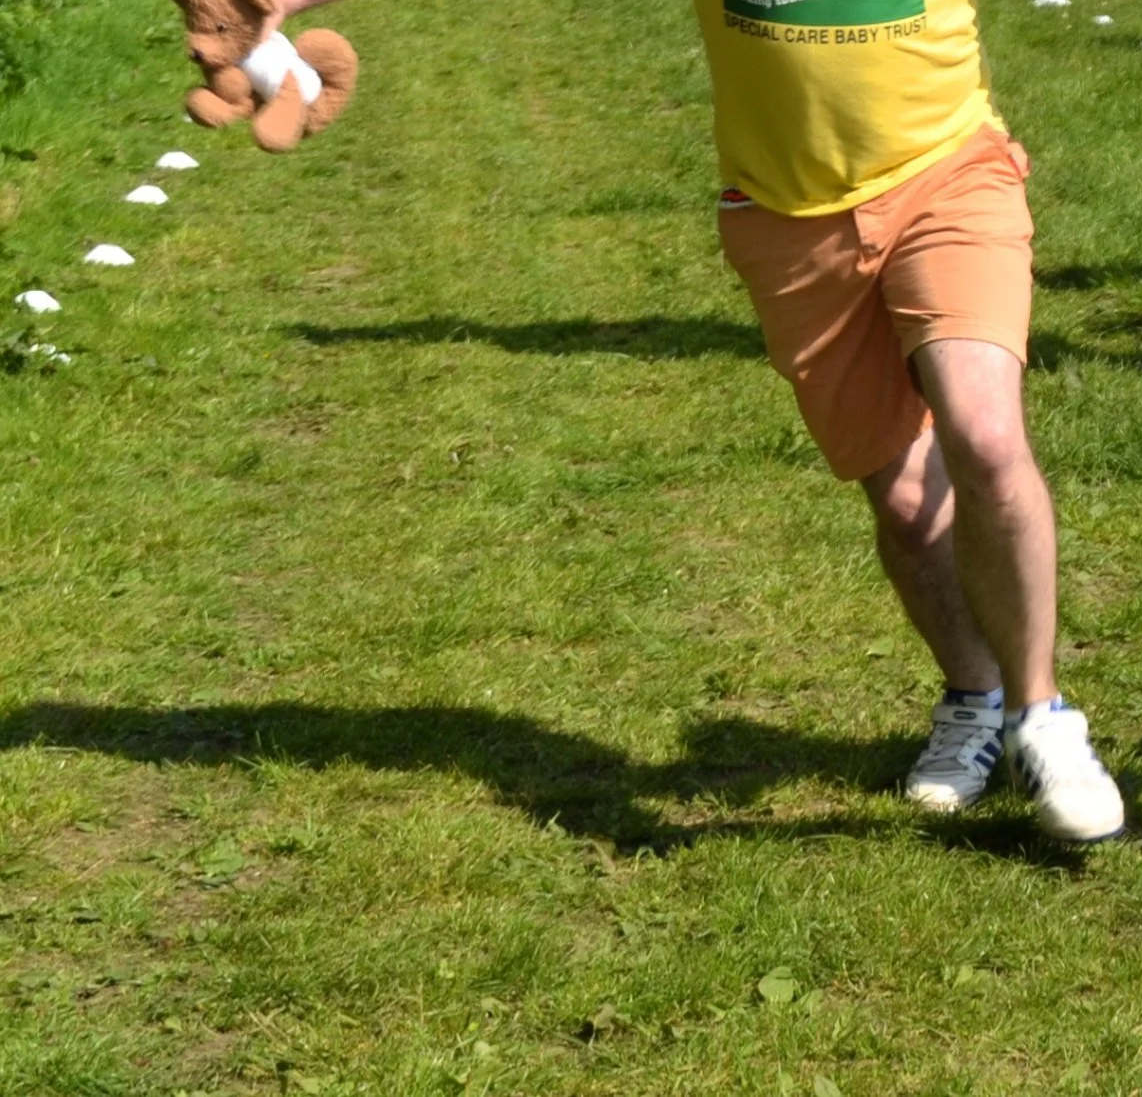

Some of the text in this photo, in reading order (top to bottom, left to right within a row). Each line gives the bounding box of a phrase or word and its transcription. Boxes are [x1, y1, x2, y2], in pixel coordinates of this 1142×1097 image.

[724, 12, 927, 44] SPECIAL CARE BABY TRUST
